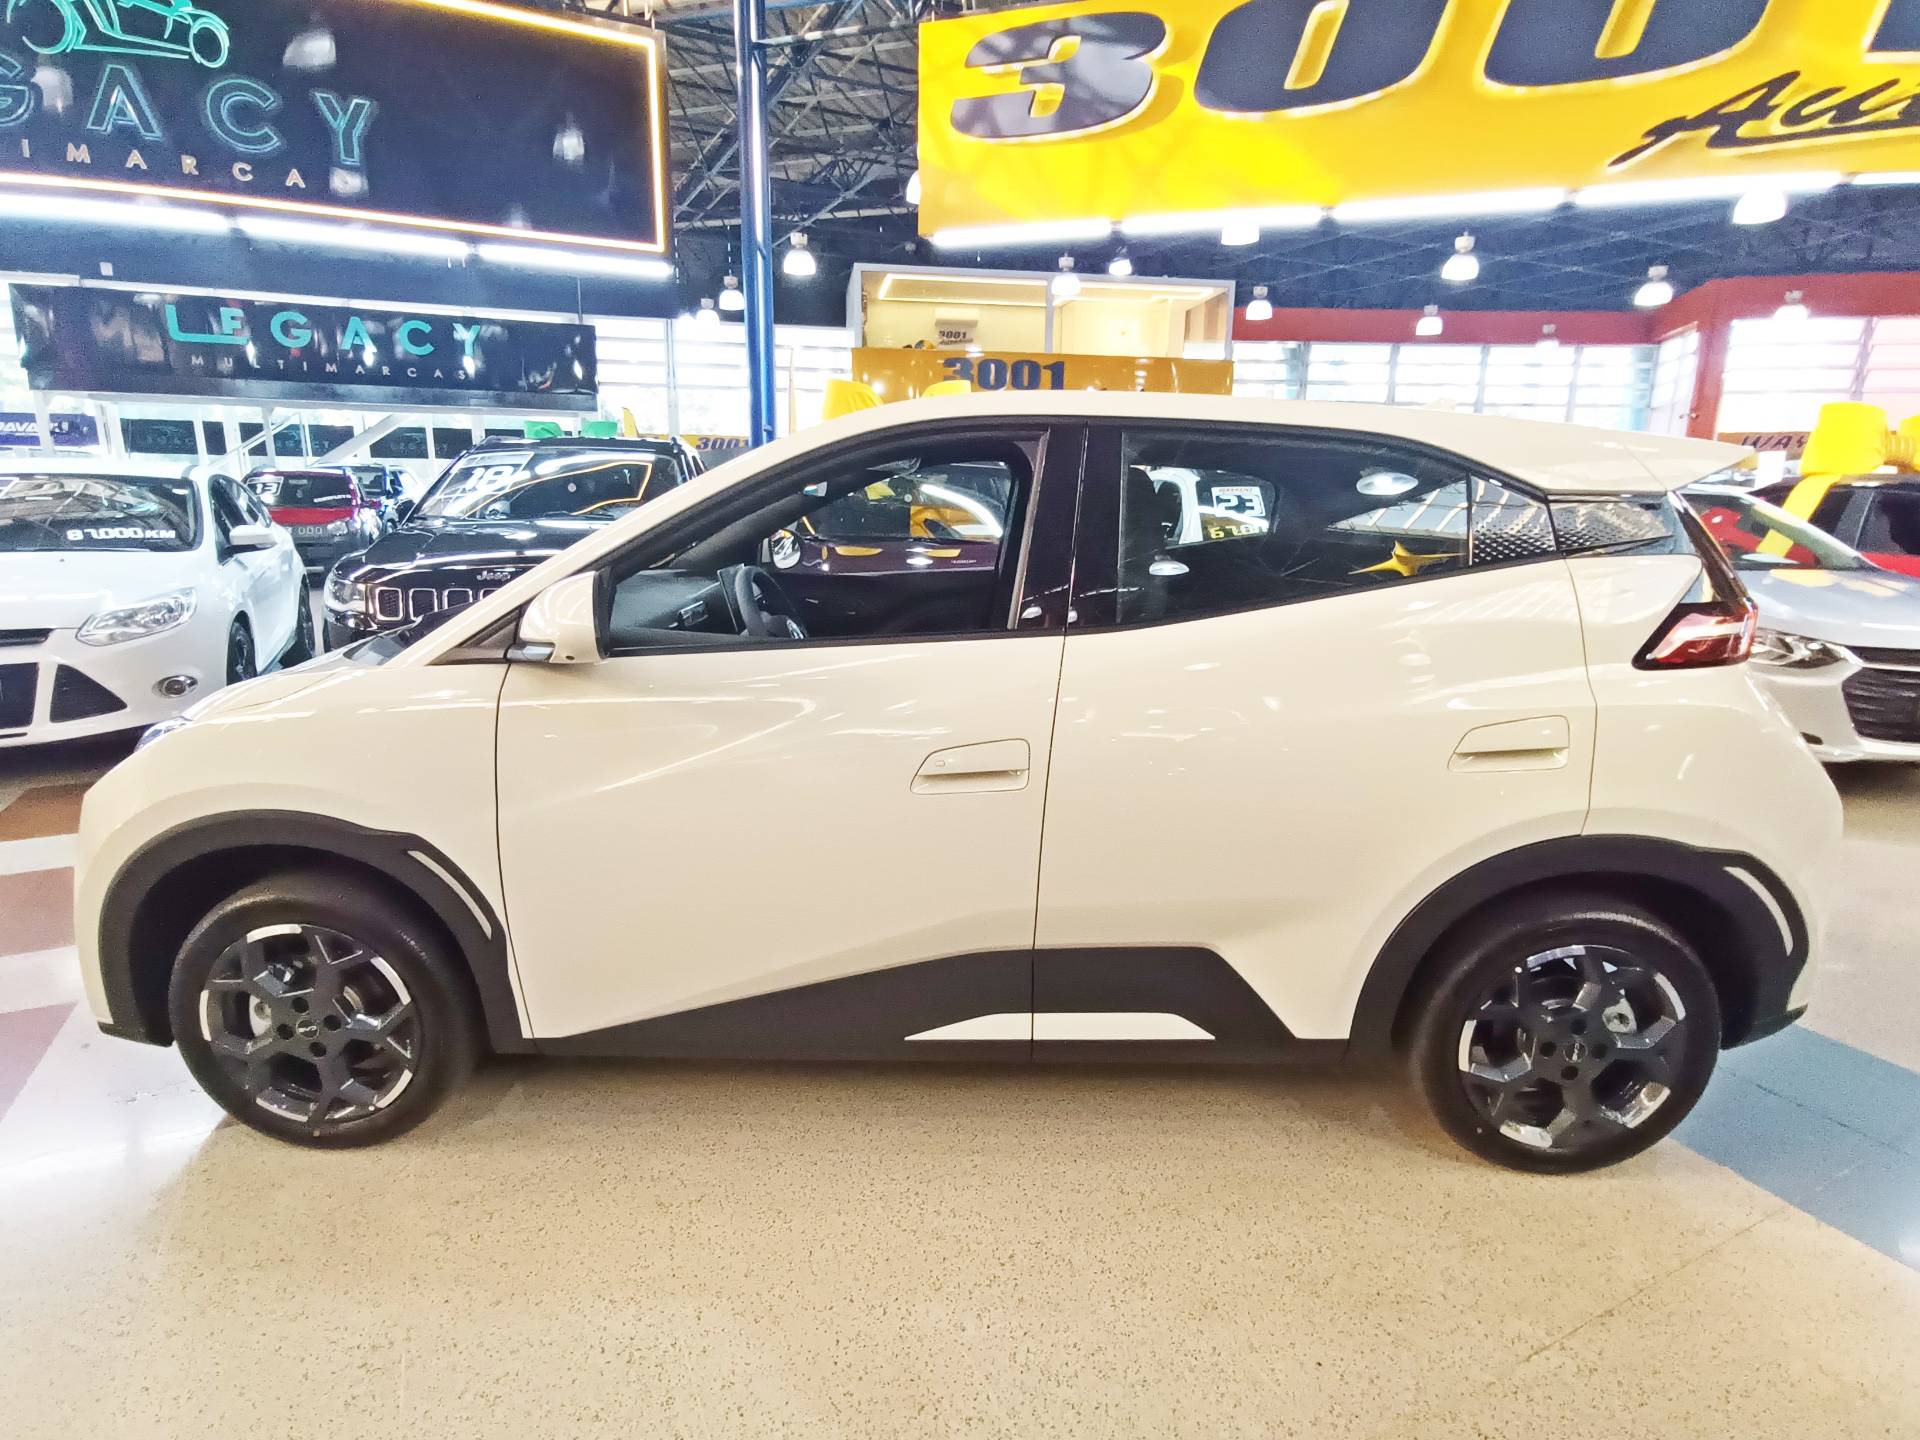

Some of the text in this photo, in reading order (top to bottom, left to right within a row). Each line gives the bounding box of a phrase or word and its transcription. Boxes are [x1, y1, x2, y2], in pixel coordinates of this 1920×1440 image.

[950, 0, 1920, 139] 300
[1606, 70, 1920, 168] Au
[20, 138, 366, 198] IMARCA
[164, 303, 481, 357] LEGACY
[190, 354, 468, 381] MULTIMARCAS
[943, 357, 1065, 391] 3001
[255, 483, 278, 495] 13
[1215, 494, 1263, 515] 23
[476, 570, 511, 582] Jeep
